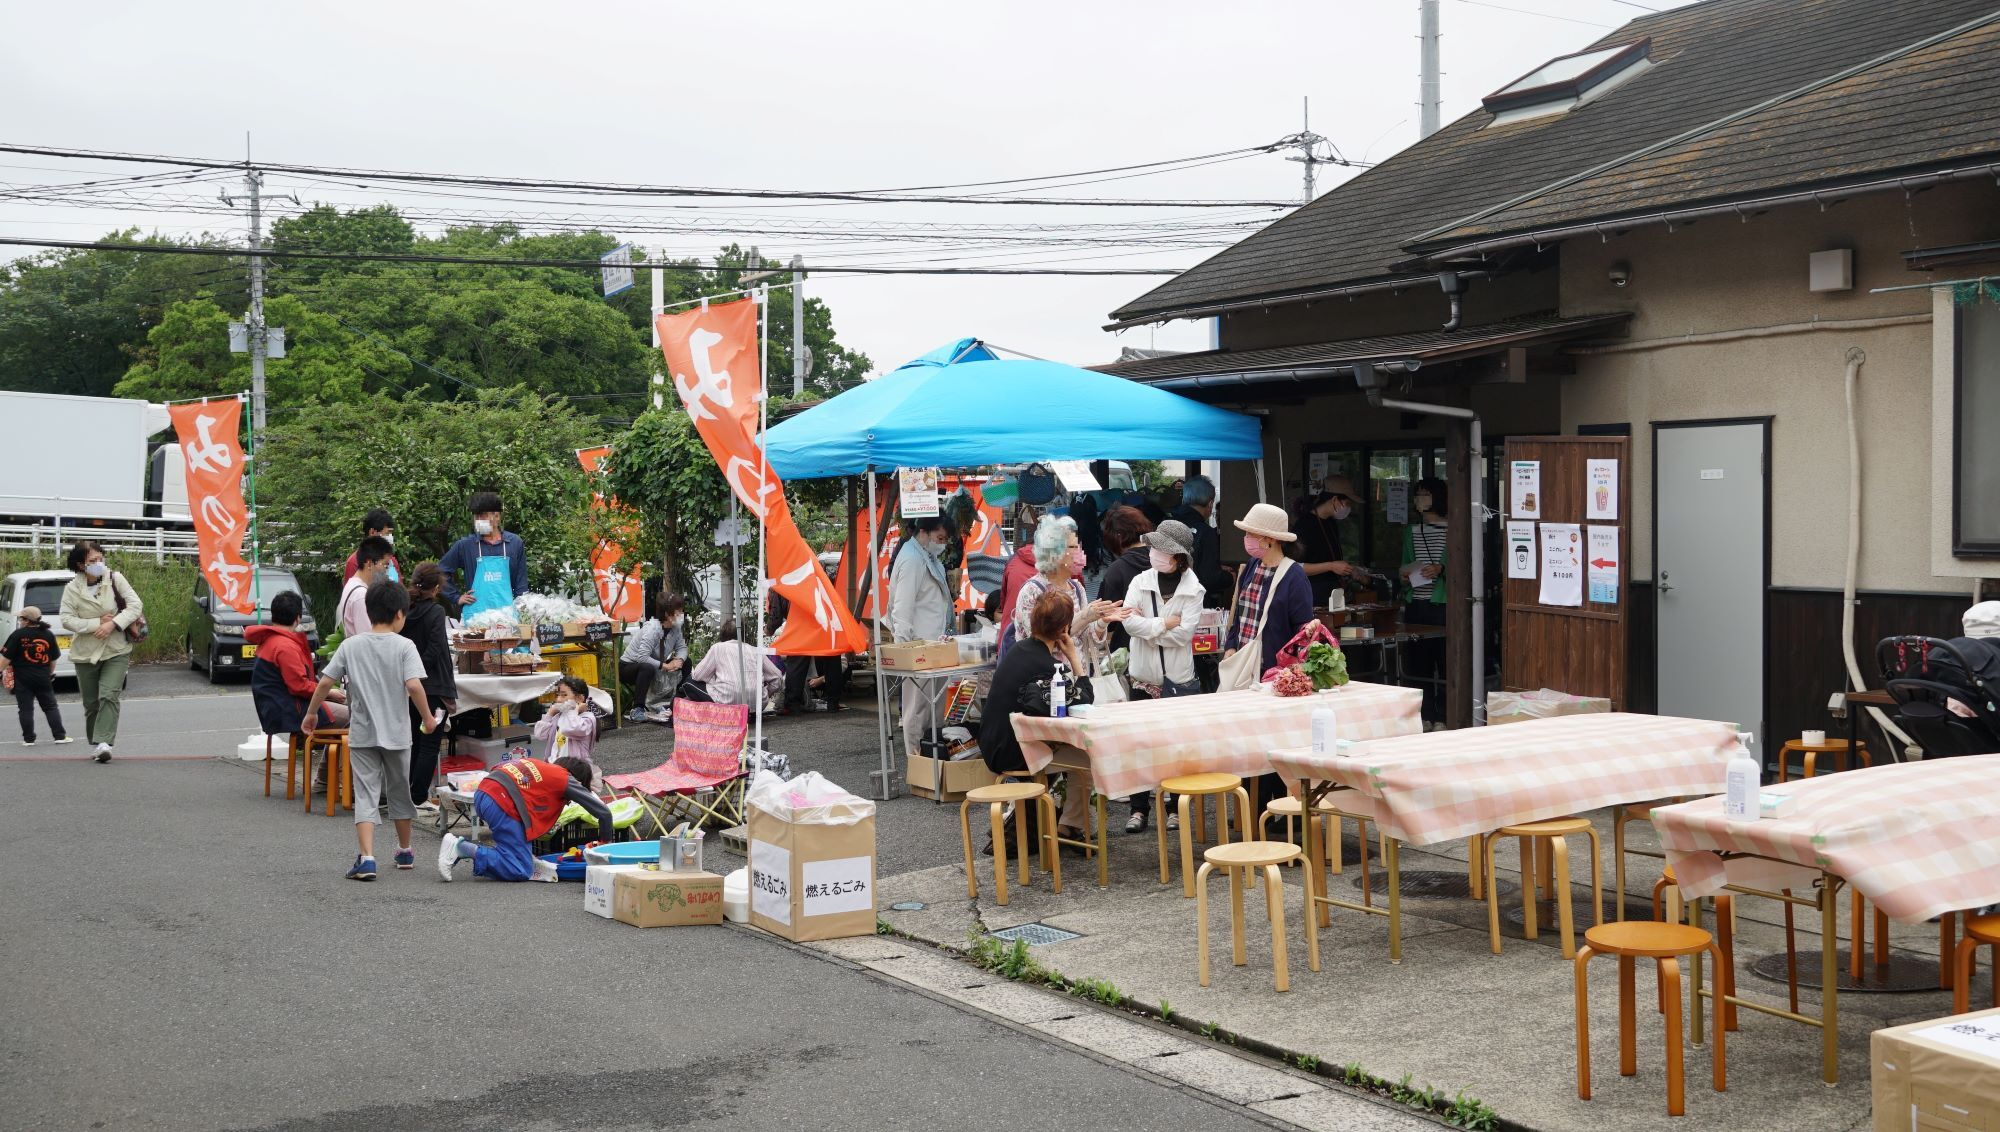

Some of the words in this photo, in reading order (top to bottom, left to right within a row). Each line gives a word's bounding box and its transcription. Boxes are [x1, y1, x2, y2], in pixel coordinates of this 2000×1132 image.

[186, 413, 249, 602] みの市
[752, 869, 788, 898] 燃えるごみ
[805, 879, 866, 899] 燃えるごみ
